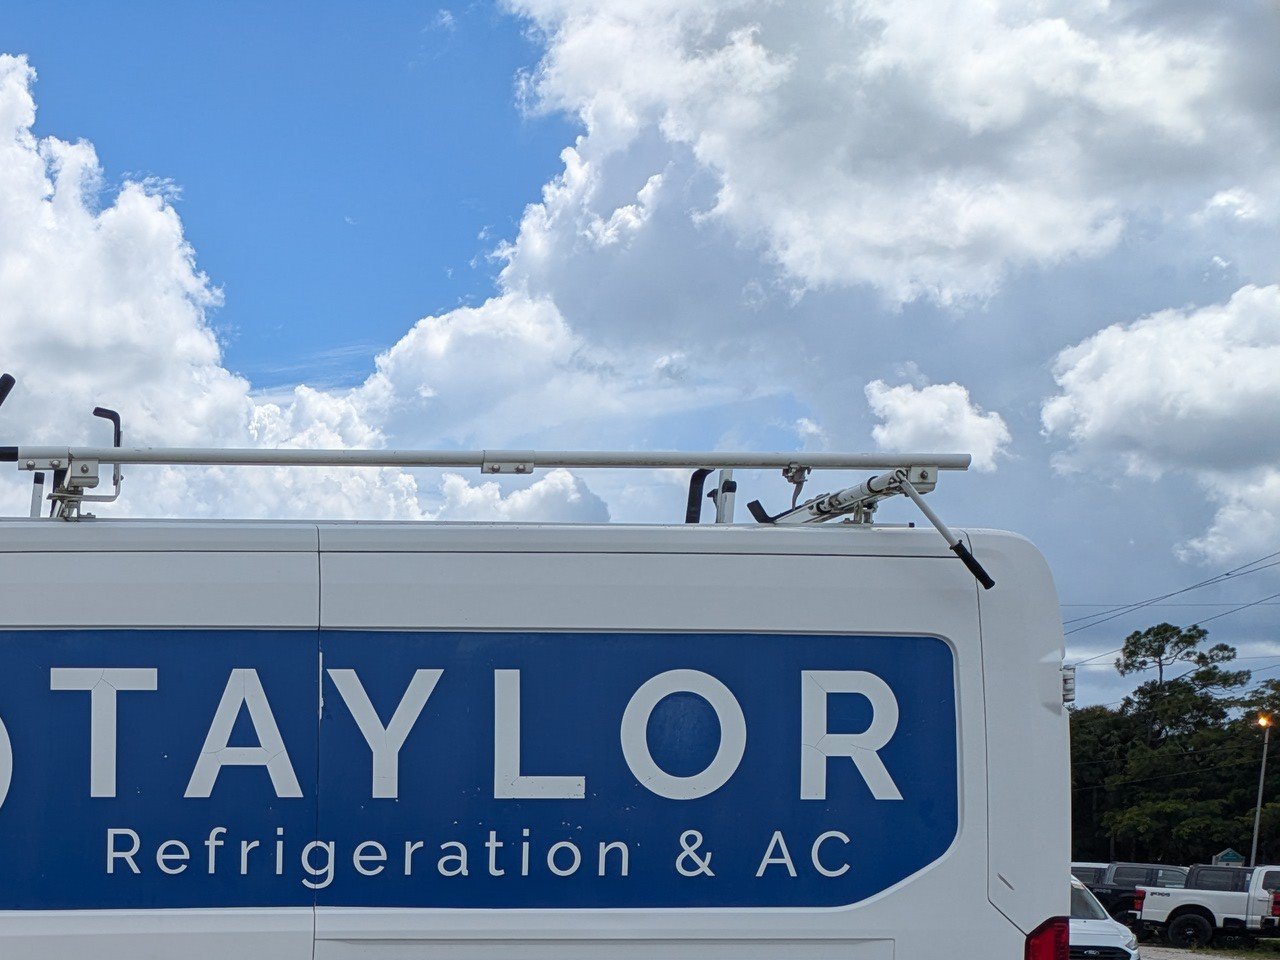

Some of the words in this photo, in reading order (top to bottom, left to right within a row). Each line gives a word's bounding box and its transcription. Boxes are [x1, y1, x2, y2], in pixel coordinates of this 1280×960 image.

[50, 667, 904, 801] TAYLOR
[107, 827, 631, 890] Refrigeration
[676, 829, 716, 878] &
[756, 830, 852, 878] AC
